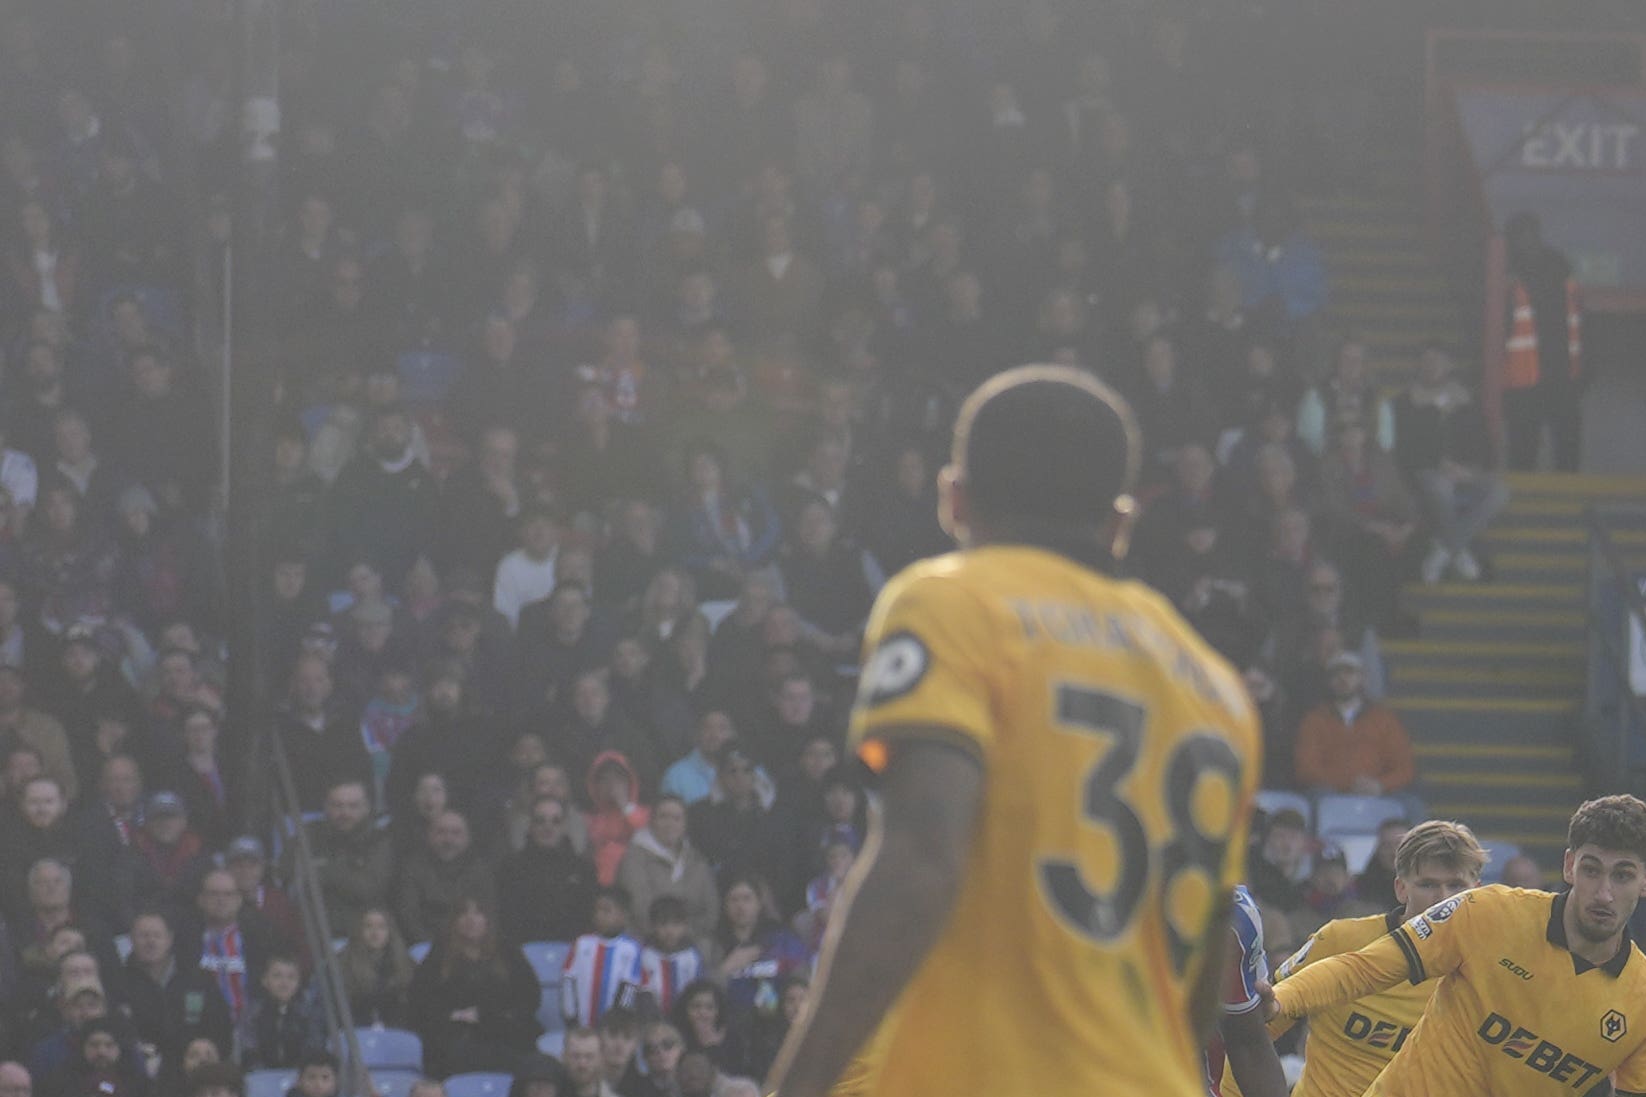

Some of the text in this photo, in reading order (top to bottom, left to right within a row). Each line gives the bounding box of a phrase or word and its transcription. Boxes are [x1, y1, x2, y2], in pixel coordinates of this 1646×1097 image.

[1521, 122, 1640, 168] EXIT
[1036, 682, 1243, 984] 38
[1478, 1012, 1602, 1090] DEBET
